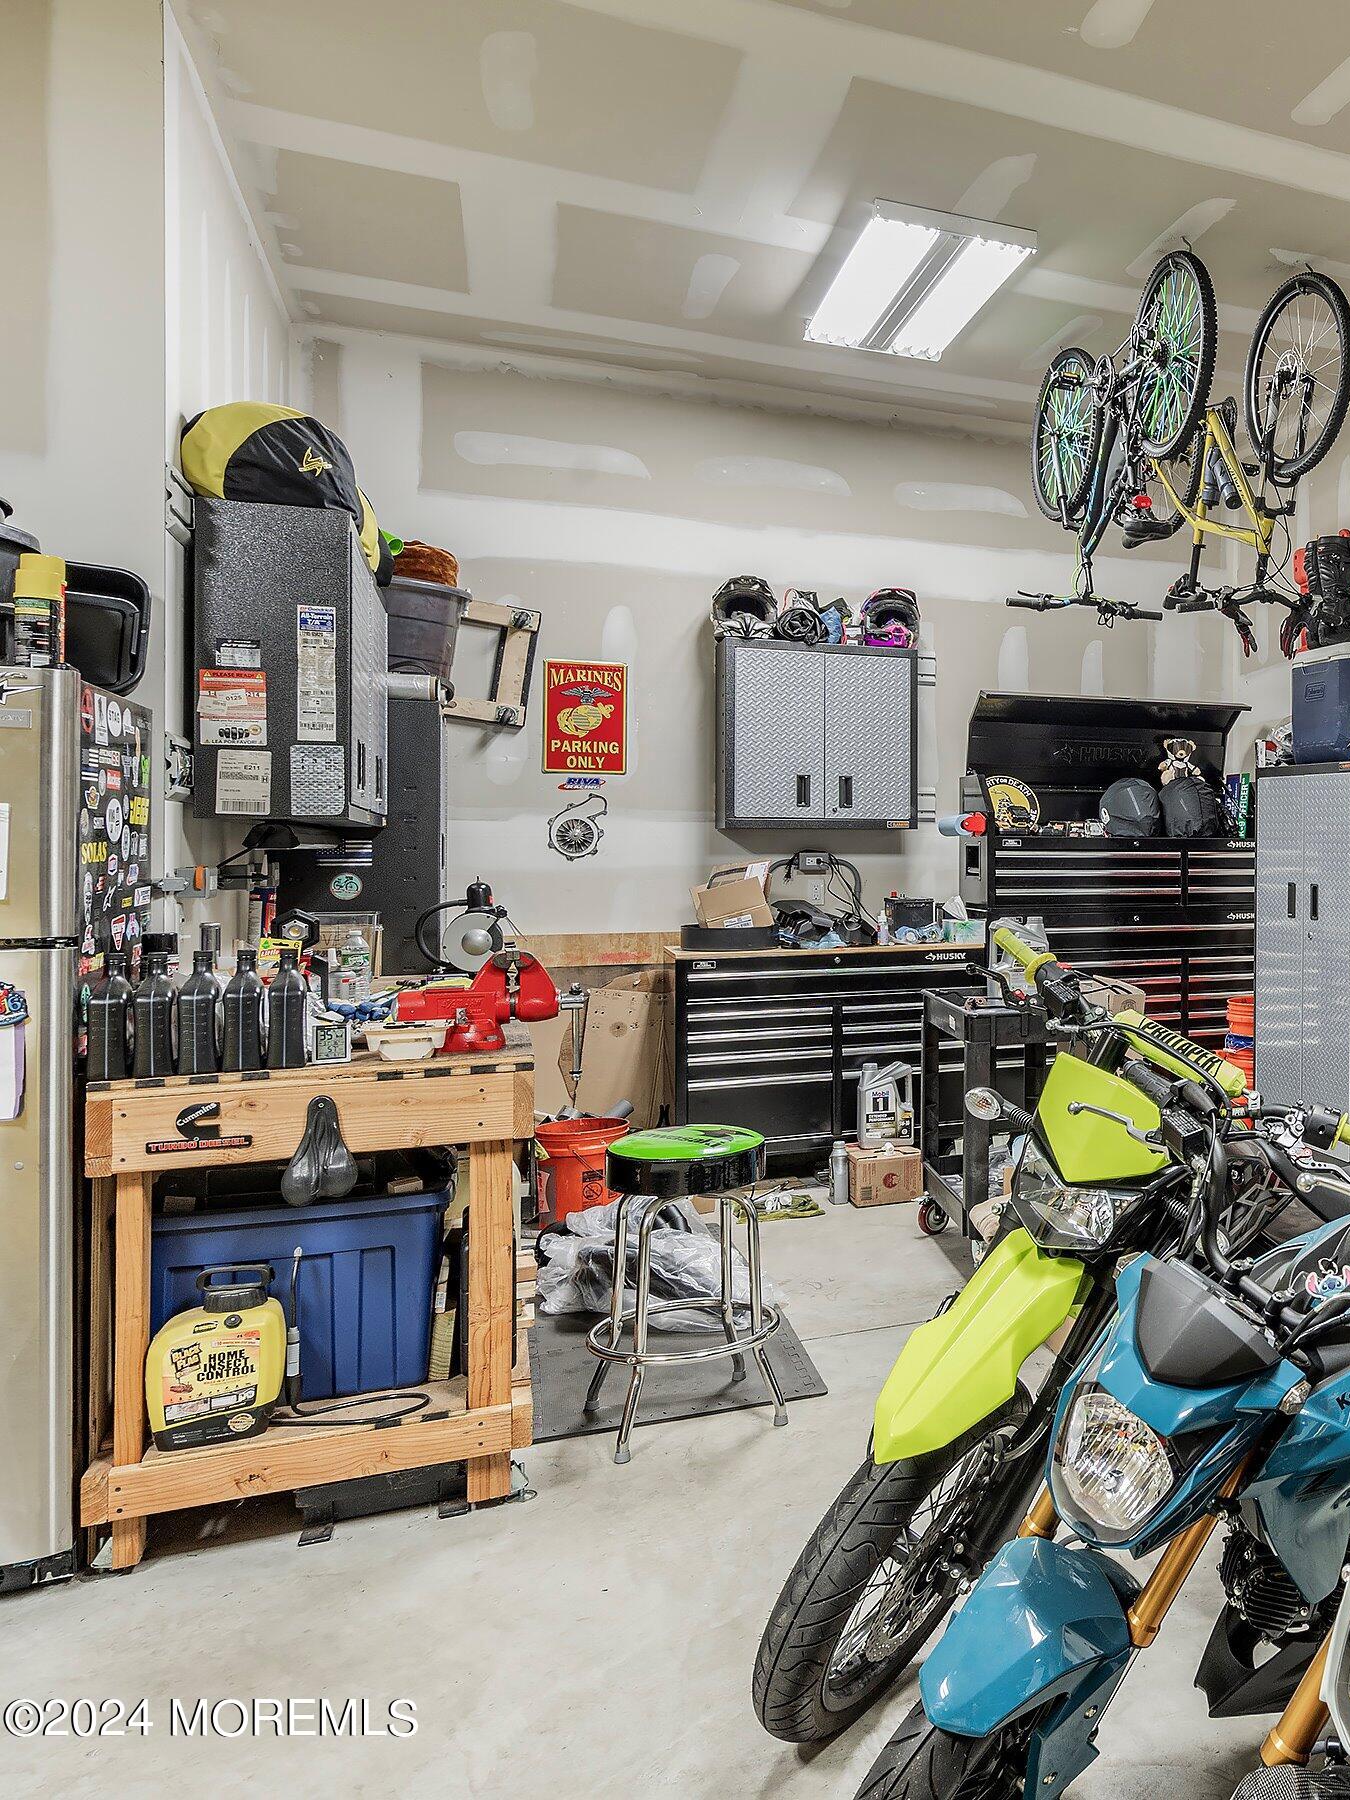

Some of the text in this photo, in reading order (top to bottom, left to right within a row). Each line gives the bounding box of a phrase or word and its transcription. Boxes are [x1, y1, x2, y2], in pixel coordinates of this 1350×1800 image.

[550, 668, 622, 692] MARINES
[551, 740, 619, 754] PARKING
[567, 756, 605, 769] ONLY
[1008, 778, 1032, 797] DEATH
[81, 842, 108, 865] SOLAS
[1235, 912, 1255, 920] HUSK
[936, 952, 967, 961] HUSKY
[176, 1102, 217, 1127] Cummins
[148, 1137, 249, 1151] TURBO DIESEL
[208, 1349, 245, 1362] HOME
[203, 1357, 250, 1372] INSECT
[196, 1364, 256, 1381] CONTROL
